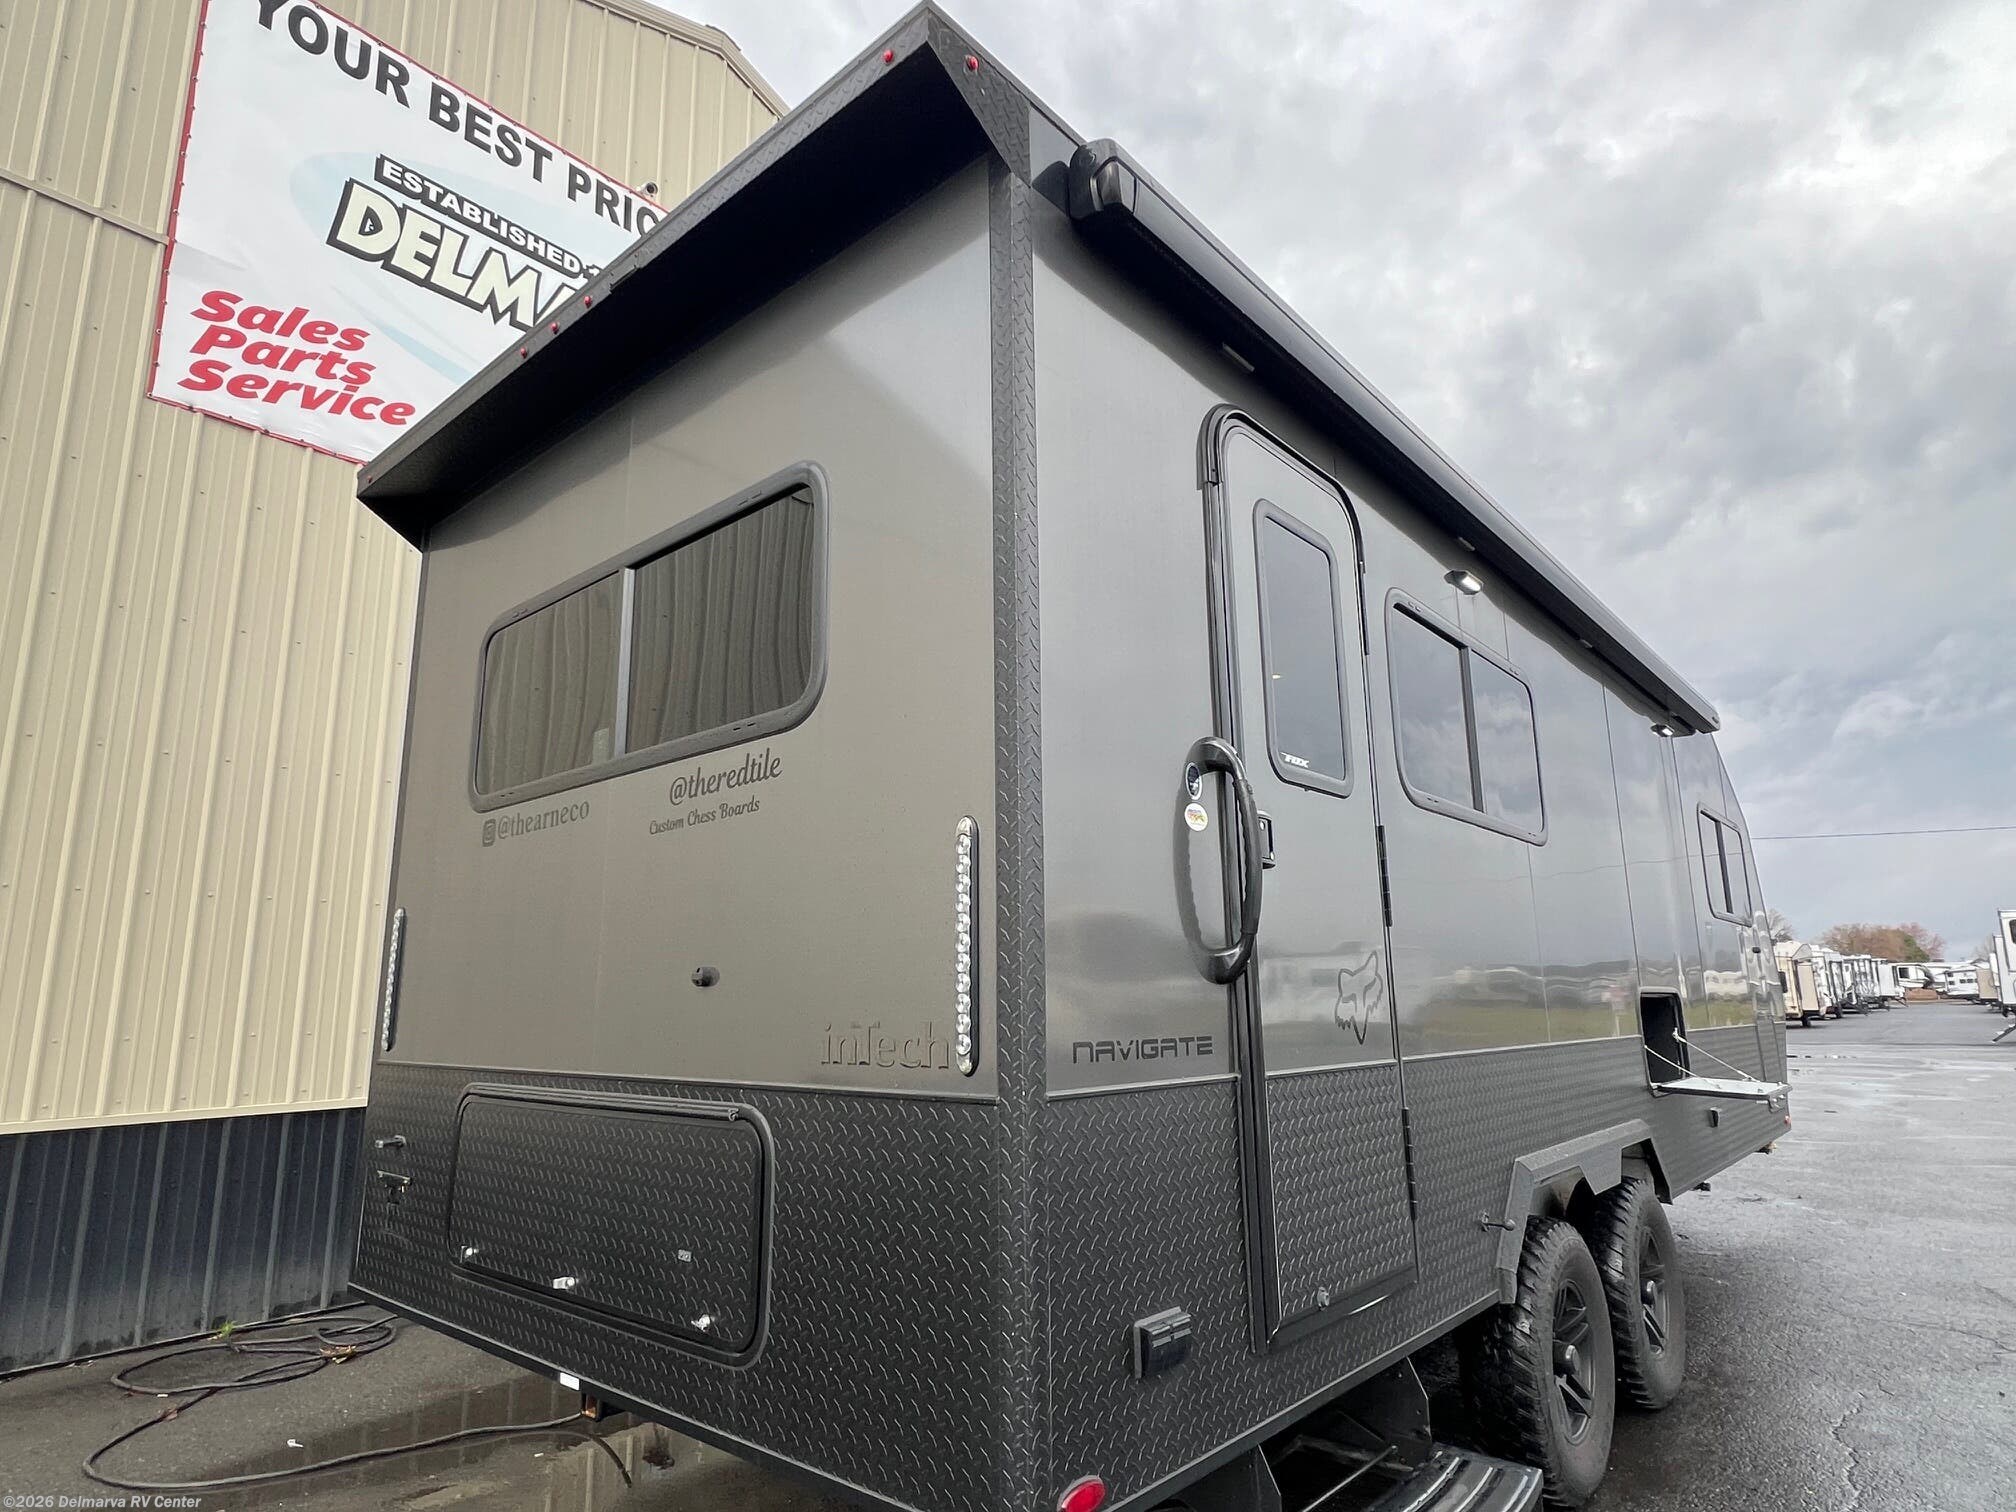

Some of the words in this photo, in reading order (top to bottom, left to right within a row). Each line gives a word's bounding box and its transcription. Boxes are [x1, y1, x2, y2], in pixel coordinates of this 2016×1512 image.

[258, 0, 410, 108] YOUR
[429, 82, 553, 183] BEST
[375, 155, 584, 278] ESTABLISHED
[190, 290, 371, 351] Sales
[189, 324, 377, 385] Parts
[177, 359, 416, 426] Service
[669, 747, 783, 806] @theredtile
[497, 801, 590, 840] @thearneco
[649, 818, 684, 835] Custom
[687, 808, 716, 827] Chess
[719, 794, 760, 819] Boards
[821, 1021, 949, 1069] inTech
[1072, 1035, 1213, 1064] NAVIGATE
